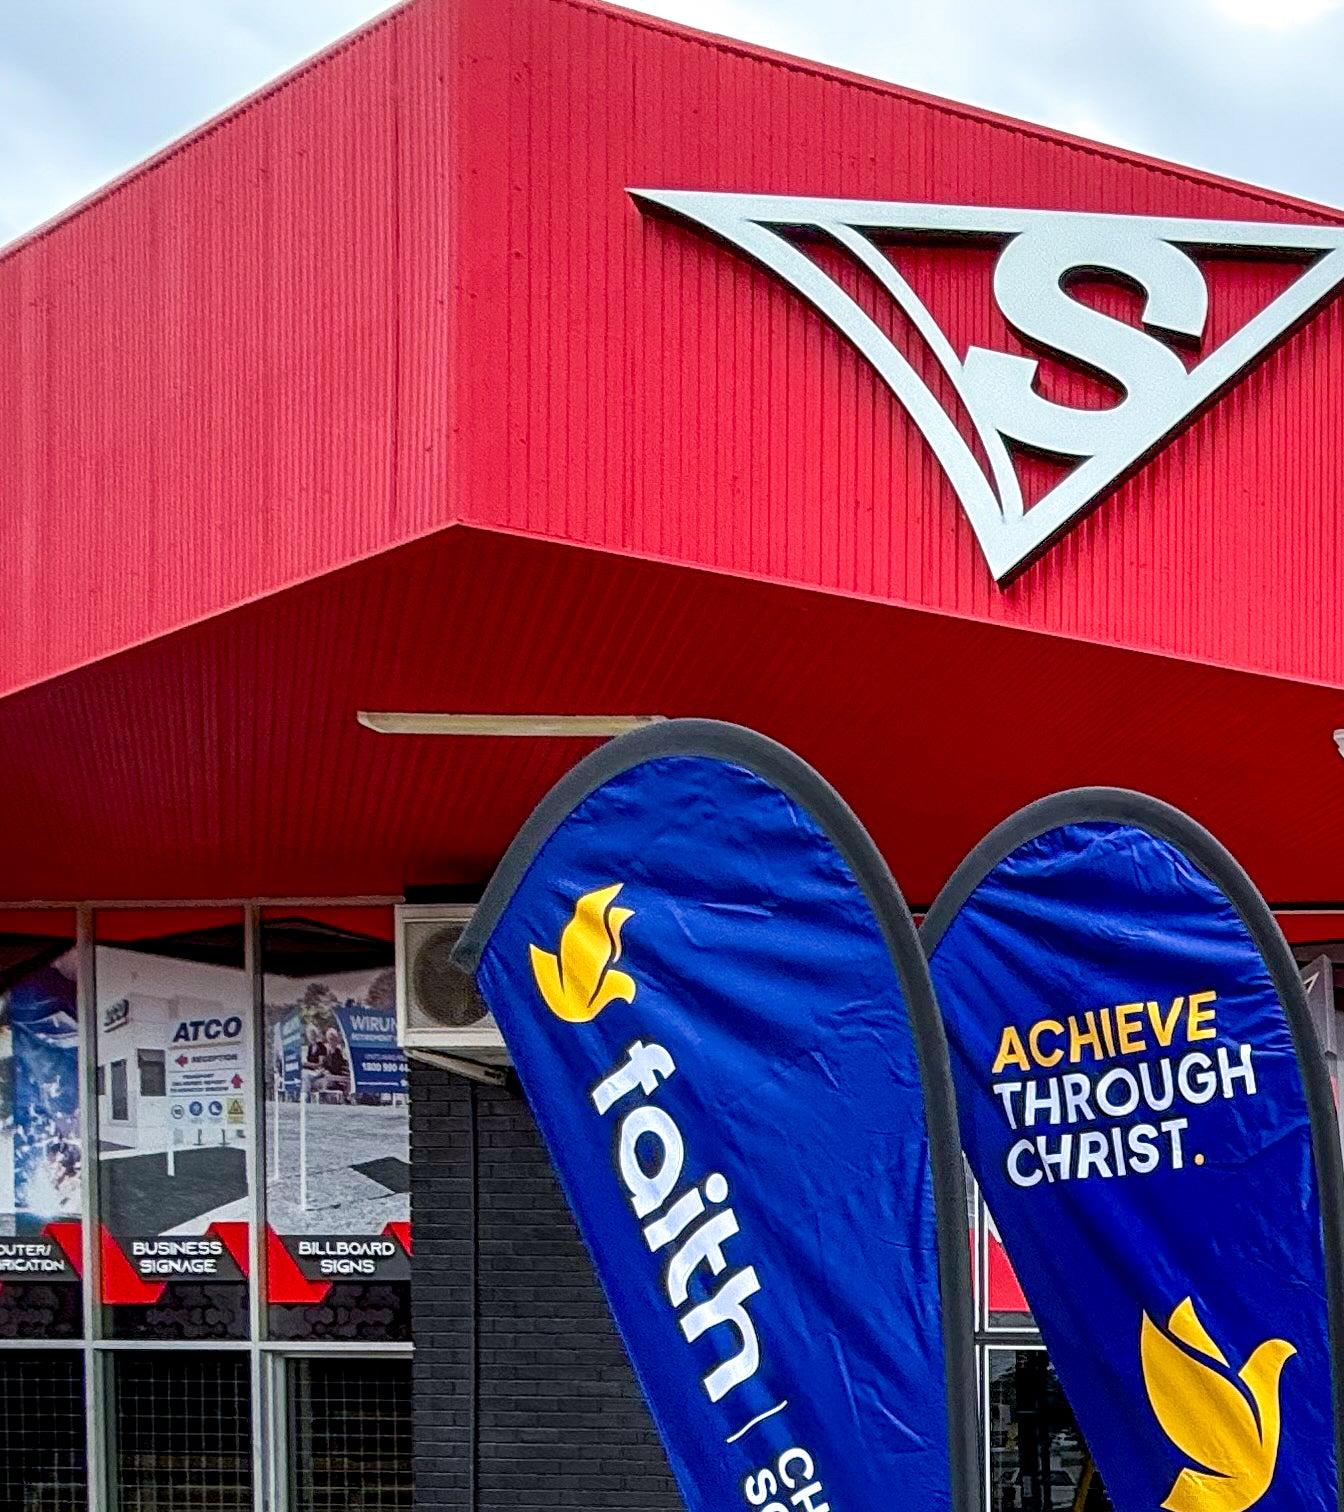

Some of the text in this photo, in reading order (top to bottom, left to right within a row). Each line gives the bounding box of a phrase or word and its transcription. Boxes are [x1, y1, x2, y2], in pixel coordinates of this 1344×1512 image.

[173, 1016, 242, 1042] ATCO
[992, 991, 1217, 1073] ACHIEVE
[992, 1044, 1257, 1129] THROUGH
[1006, 1119, 1205, 1187] CHRIST.
[592, 1040, 761, 1402] faith
[133, 1241, 222, 1256] BUSINESS
[299, 1241, 395, 1256] BILLBOARD
[139, 1259, 217, 1274] SIGNAGE
[320, 1259, 375, 1274] SIGNS
